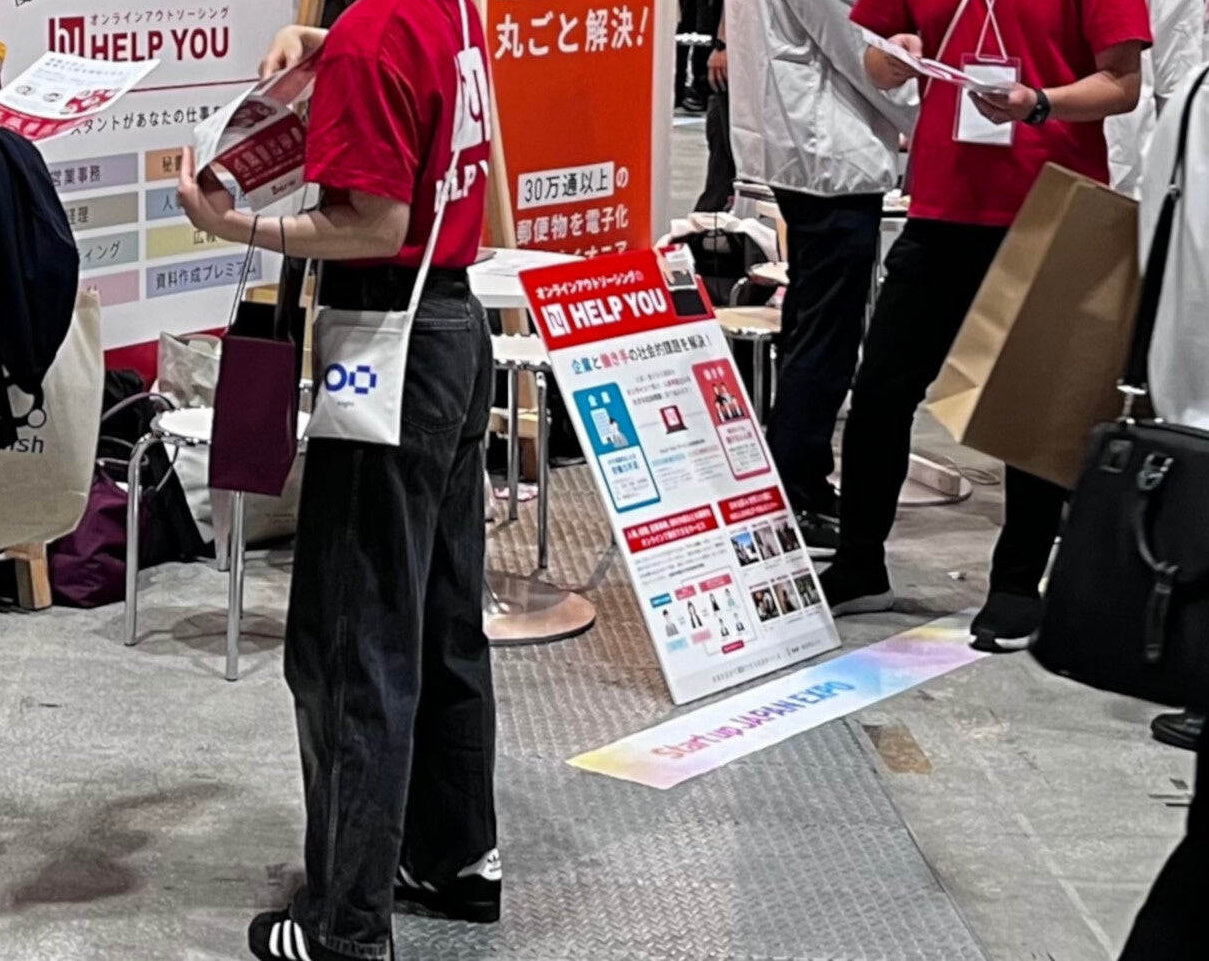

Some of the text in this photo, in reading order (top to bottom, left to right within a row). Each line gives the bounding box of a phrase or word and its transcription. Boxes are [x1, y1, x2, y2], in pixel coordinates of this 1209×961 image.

[91, 6, 230, 26] オンラインアウトソーシング
[494, 5, 649, 60] 丸ごと解決!
[91, 26, 229, 63] HELP YOU
[525, 167, 629, 203] 30万通以上の
[517, 204, 629, 246] 郵便物を電子化
[80, 240, 121, 262] ィング
[569, 288, 668, 329] HELP YOU
[729, 699, 799, 731] JAPAN
[793, 681, 856, 709] EXPO
